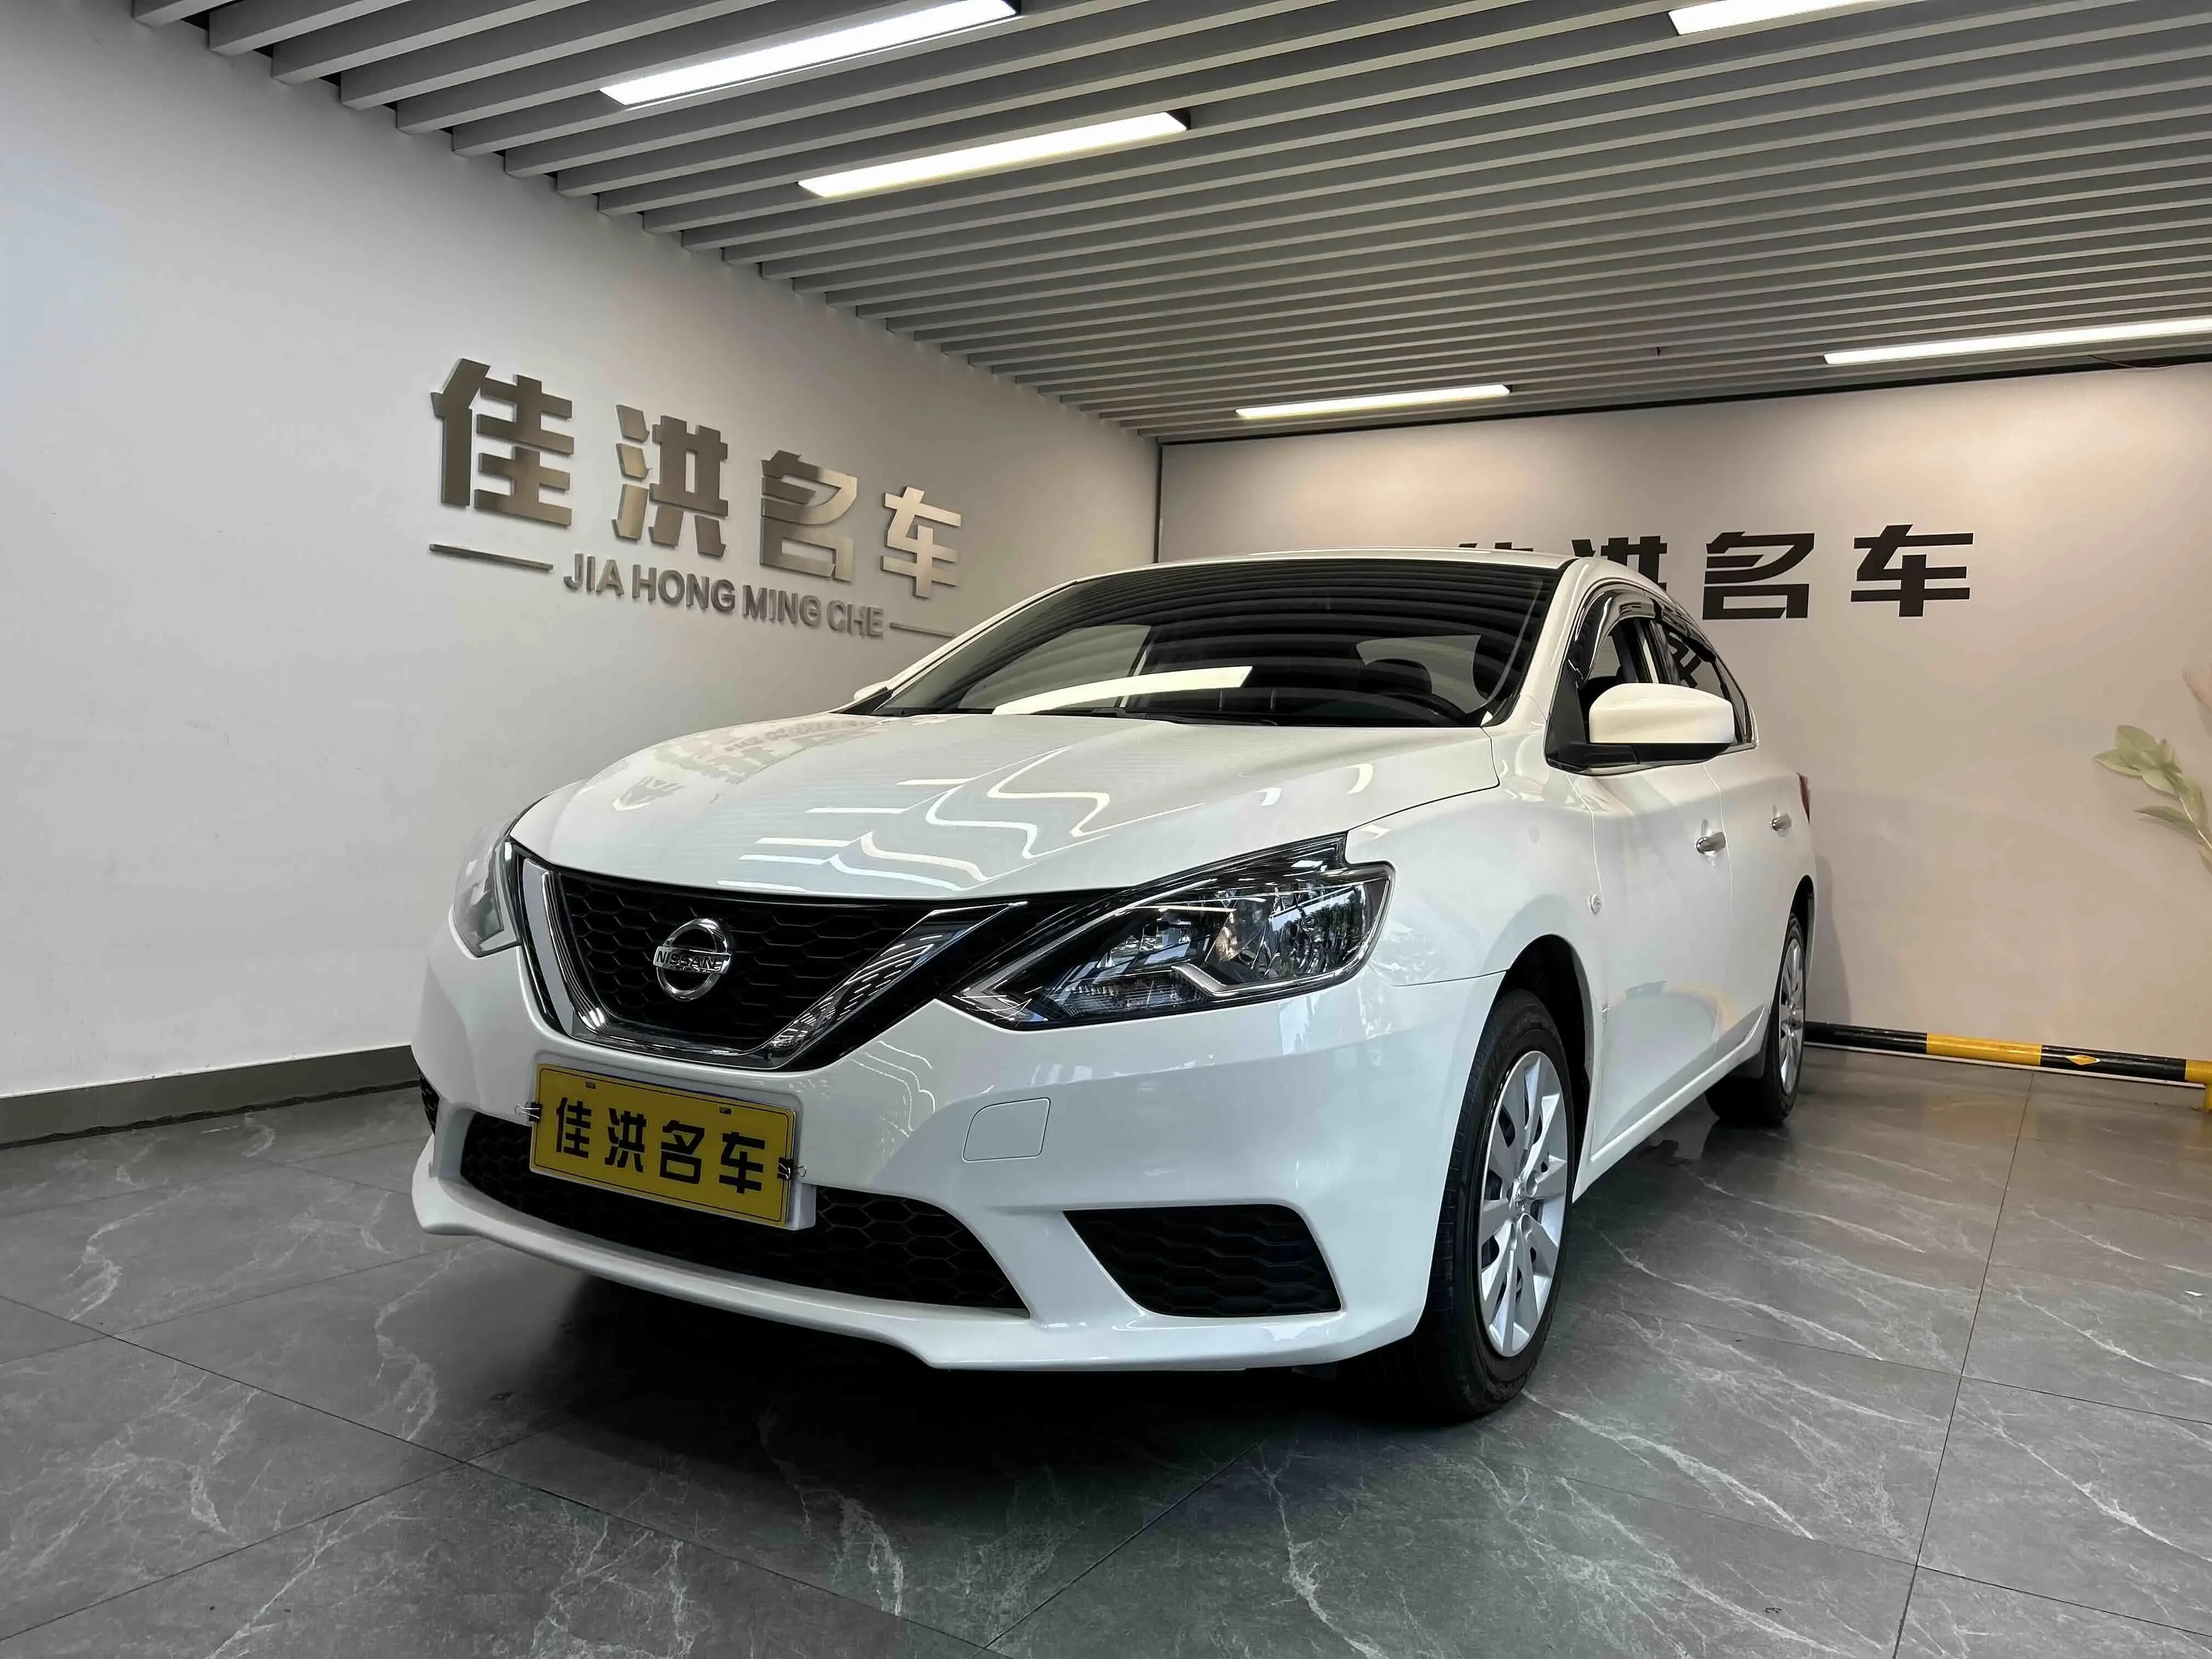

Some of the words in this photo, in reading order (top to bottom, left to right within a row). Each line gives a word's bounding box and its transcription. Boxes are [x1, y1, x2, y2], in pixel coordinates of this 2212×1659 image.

[431, 358, 961, 599] 佳洪名车
[563, 553, 624, 596] JIA
[631, 564, 736, 612] HONG
[742, 584, 822, 628] MING
[826, 600, 884, 637] CHE
[656, 950, 716, 970] NISSAN
[556, 1097, 766, 1194] 佳洪名车
